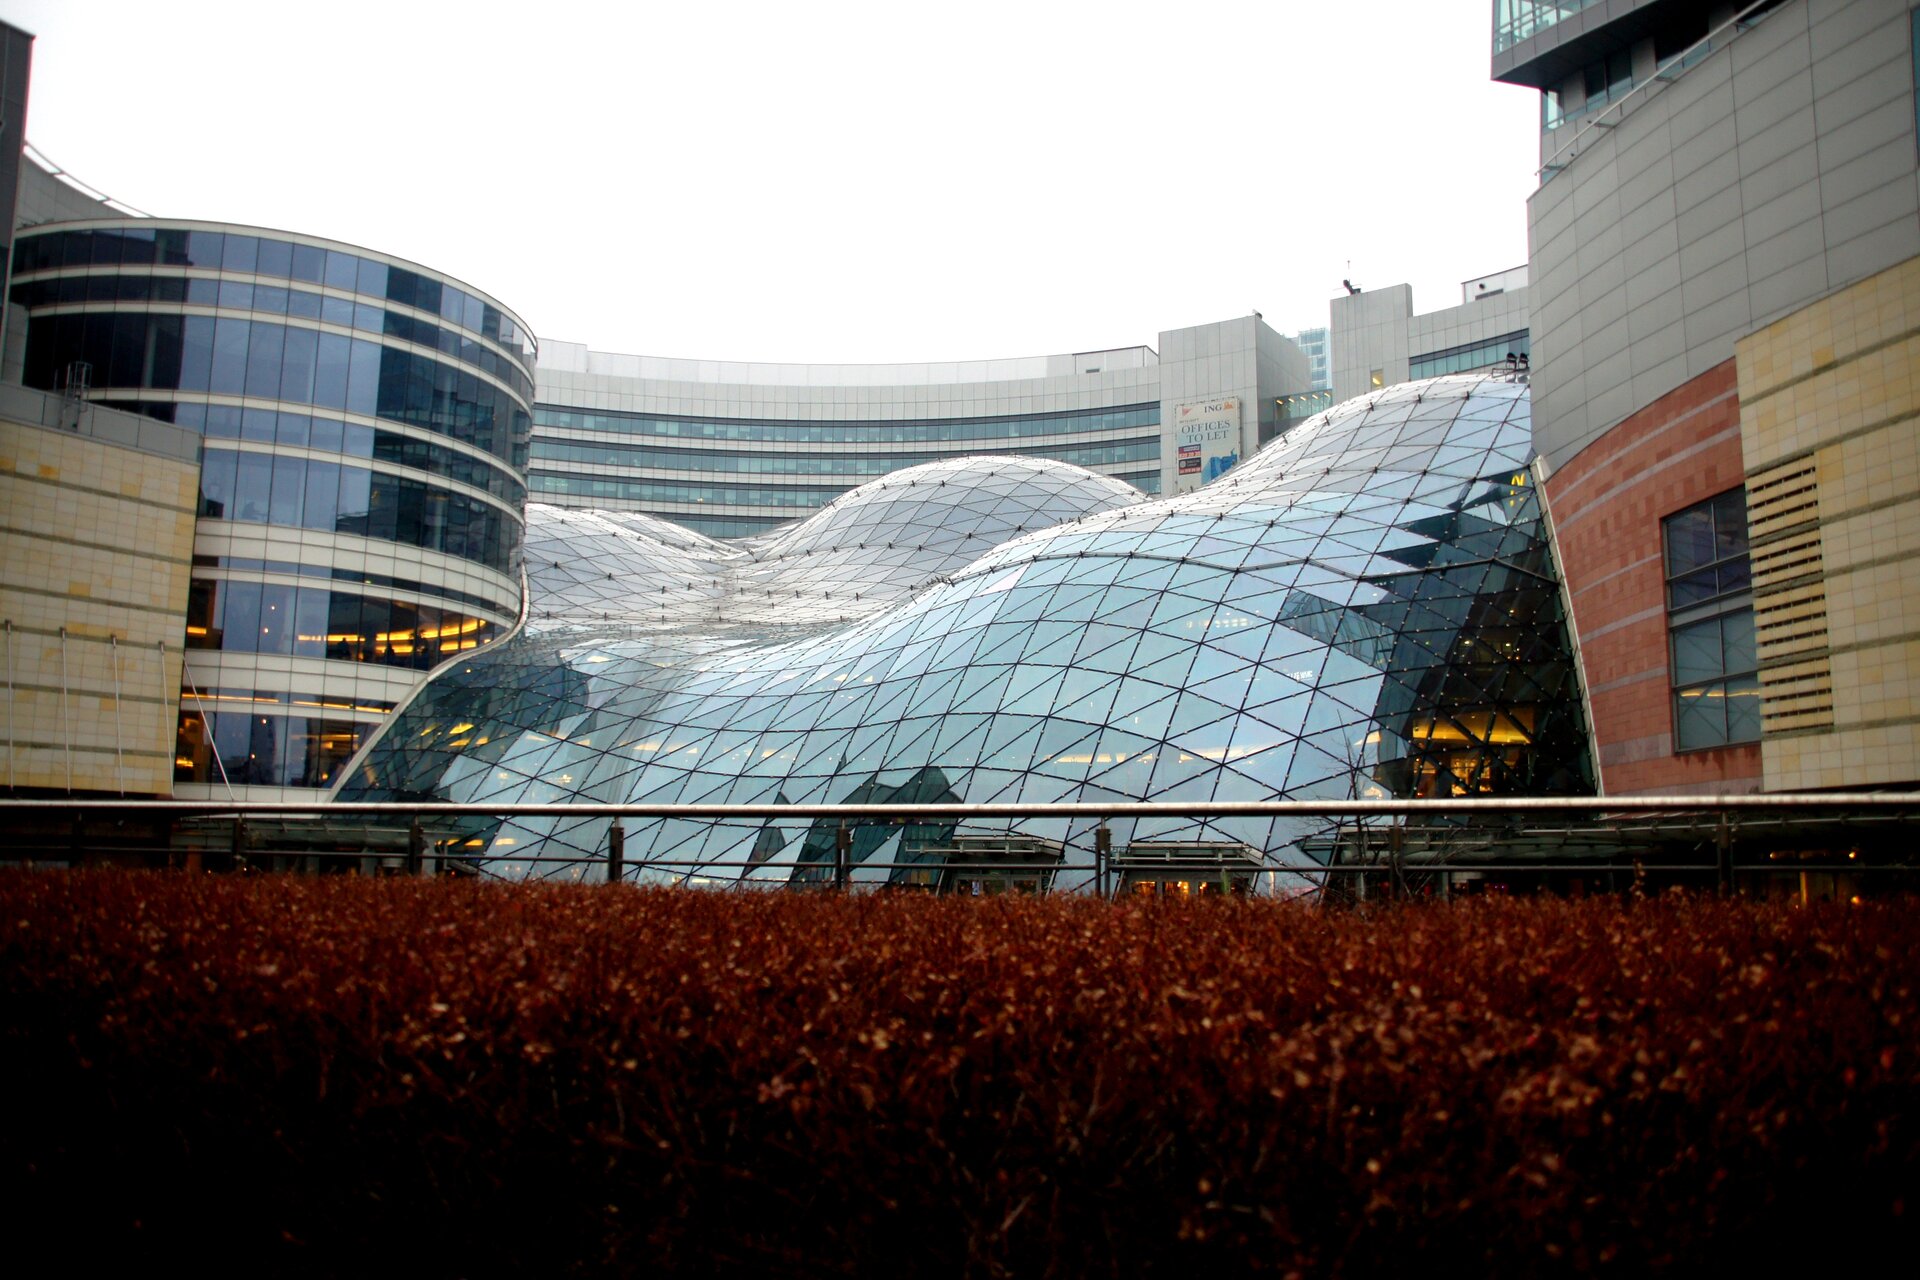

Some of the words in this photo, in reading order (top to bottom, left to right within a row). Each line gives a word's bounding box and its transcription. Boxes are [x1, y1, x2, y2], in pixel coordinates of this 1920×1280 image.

[1204, 404, 1222, 413] ING
[1181, 420, 1231, 434] OFFICES
[1186, 433, 1204, 443] TO
[1207, 429, 1229, 441] LET
